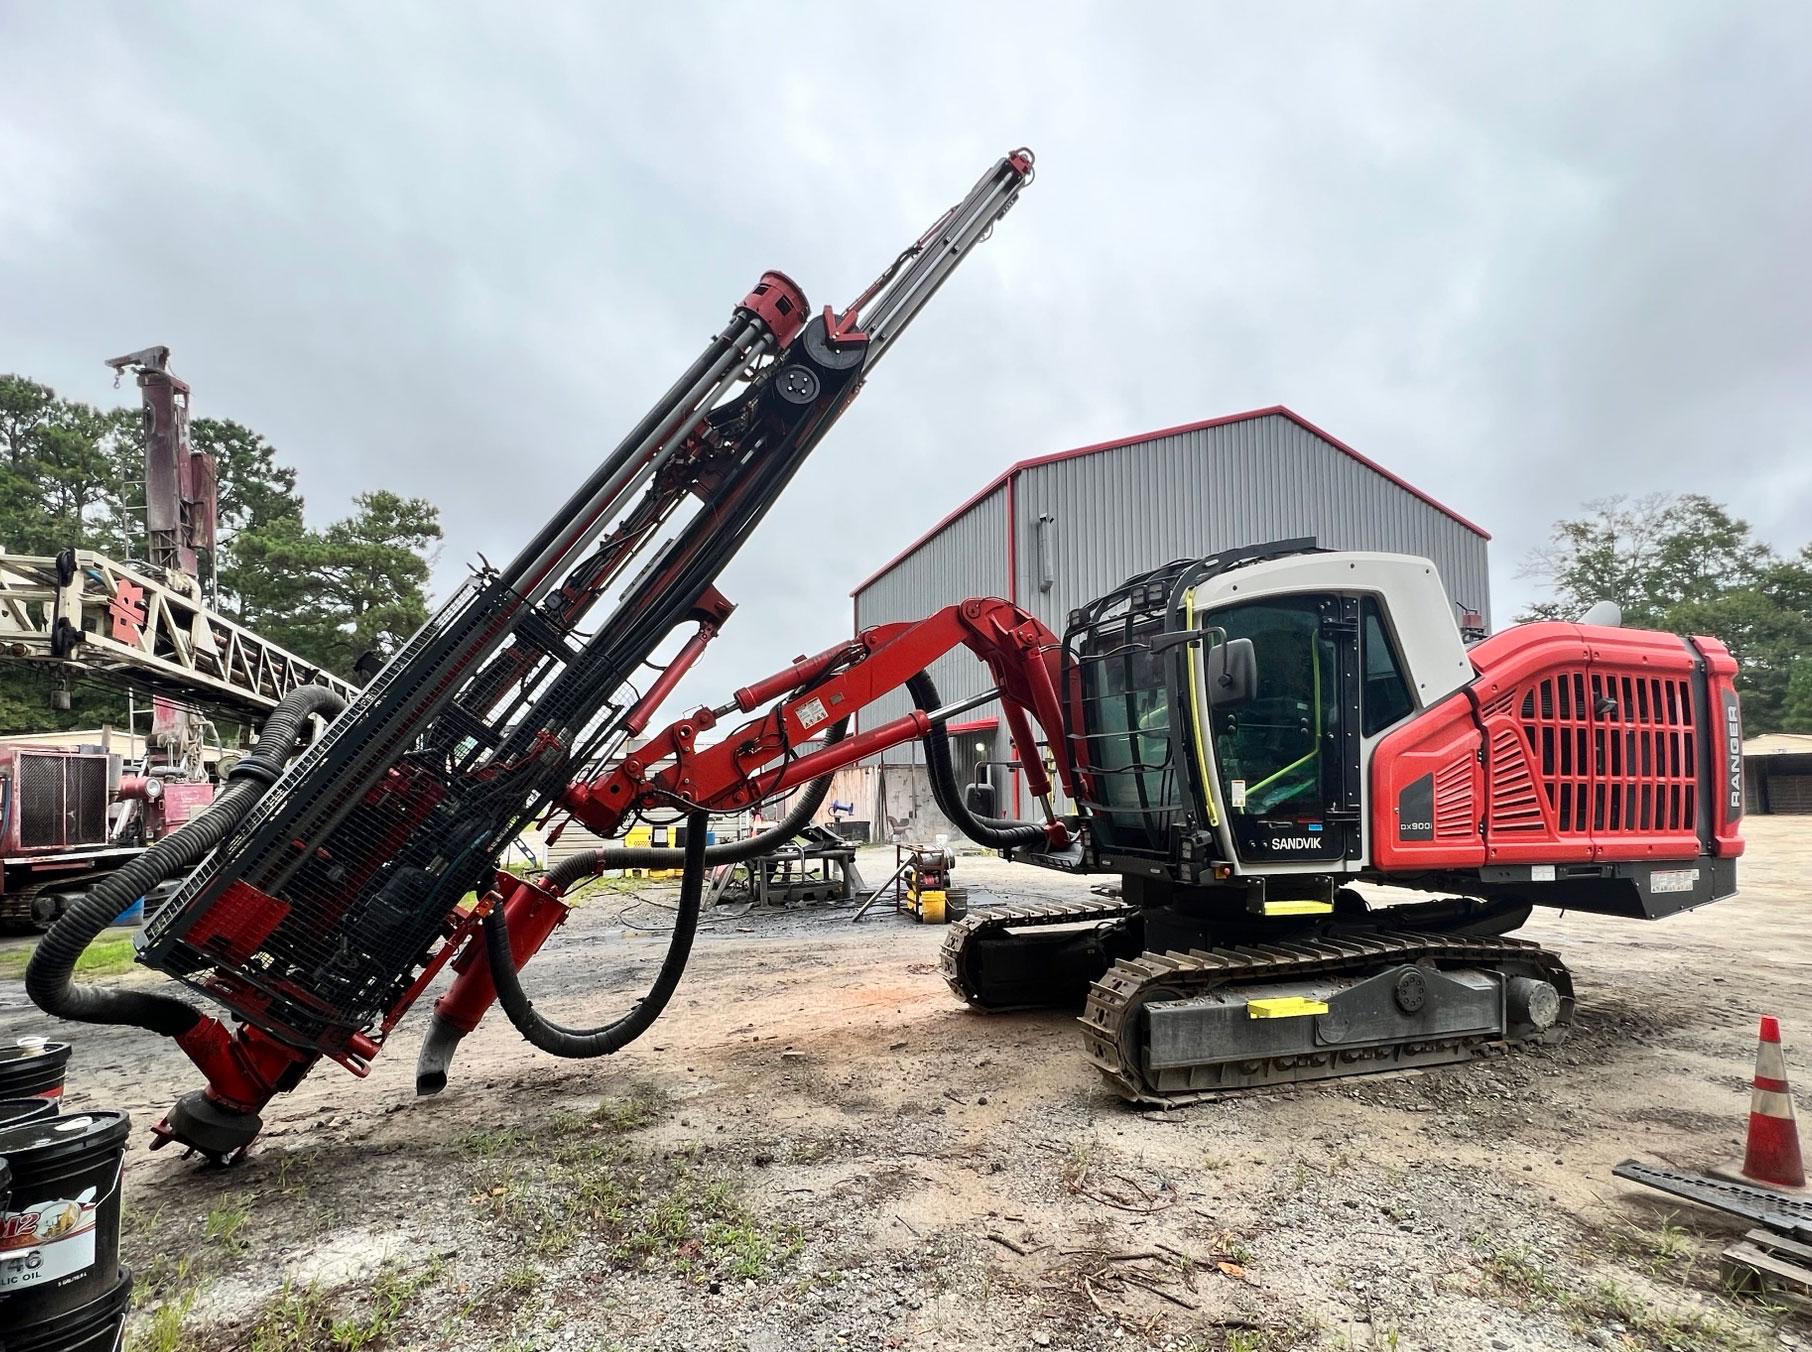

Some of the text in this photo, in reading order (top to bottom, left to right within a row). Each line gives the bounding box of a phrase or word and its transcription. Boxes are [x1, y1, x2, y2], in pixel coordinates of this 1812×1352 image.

[1728, 706, 1740, 807] RANGER
[1271, 837, 1322, 850] SANDVIK
[22, 1271, 41, 1281] OIL
